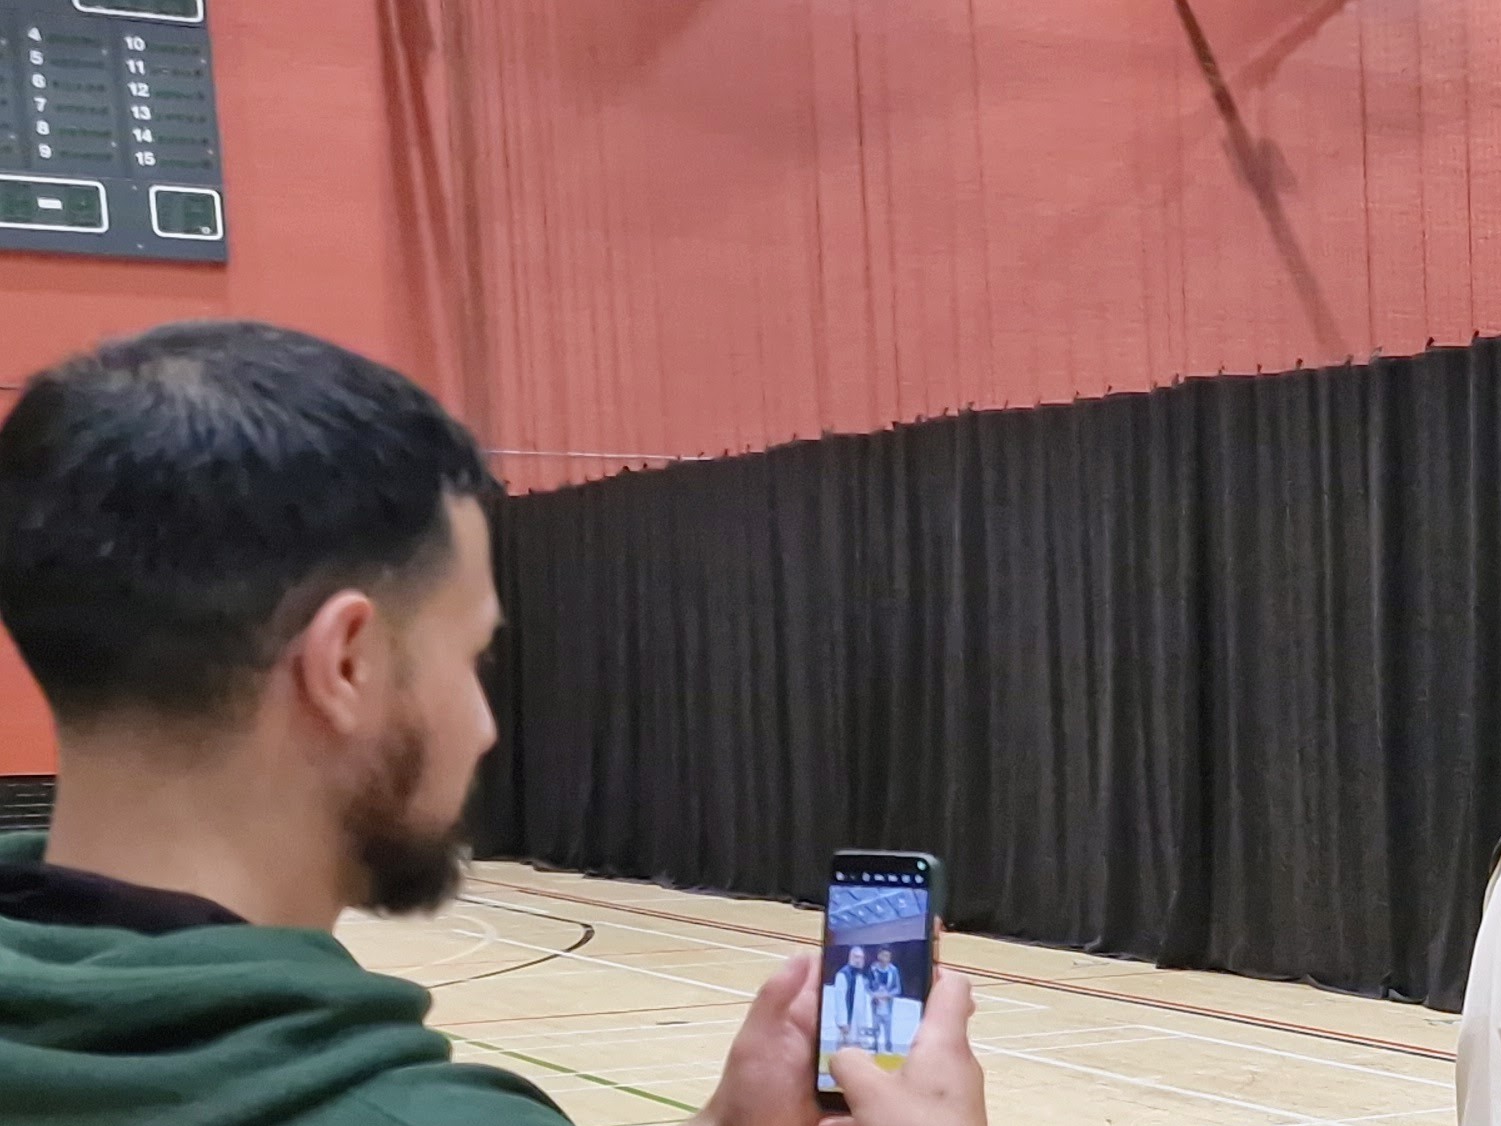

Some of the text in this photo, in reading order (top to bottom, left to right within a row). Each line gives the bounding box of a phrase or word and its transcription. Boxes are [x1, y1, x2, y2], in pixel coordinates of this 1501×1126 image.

[124, 35, 146, 51] 10
[29, 50, 43, 66] 5
[126, 59, 146, 75] 11
[31, 73, 46, 88] 6
[127, 82, 150, 97] 12
[33, 96, 47, 112] 7
[130, 105, 151, 120] 13
[132, 127, 153, 143] 14
[38, 143, 52, 158] 9
[135, 151, 156, 166] 15
